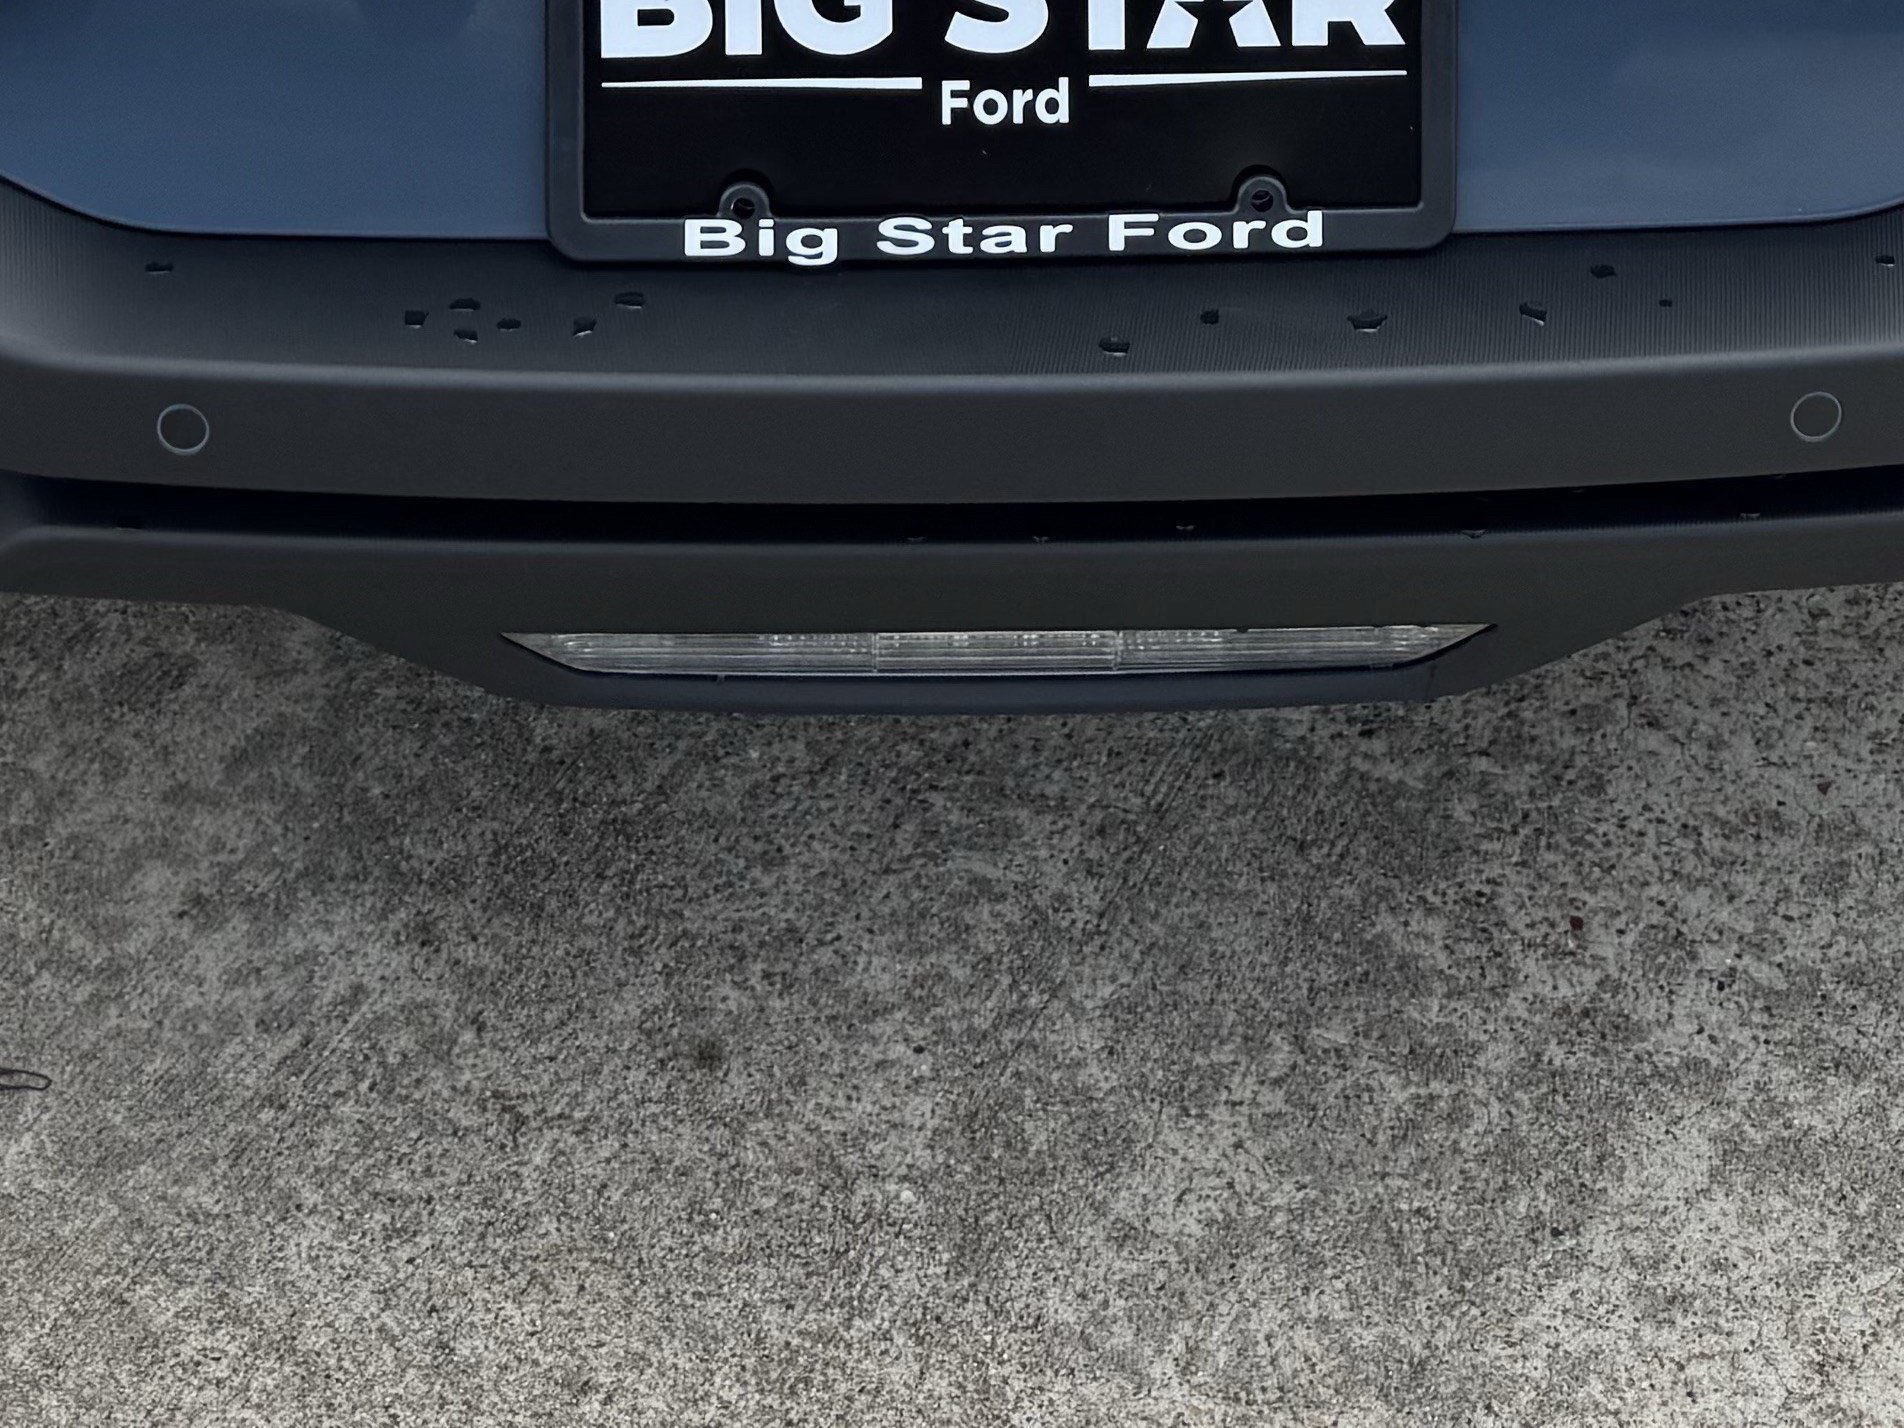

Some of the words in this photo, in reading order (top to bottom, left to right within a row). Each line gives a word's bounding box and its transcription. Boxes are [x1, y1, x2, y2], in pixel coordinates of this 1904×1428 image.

[941, 77, 1070, 126] Ford
[683, 216, 838, 267] Big
[876, 216, 1074, 256] Star
[1107, 211, 1324, 251] Ford
